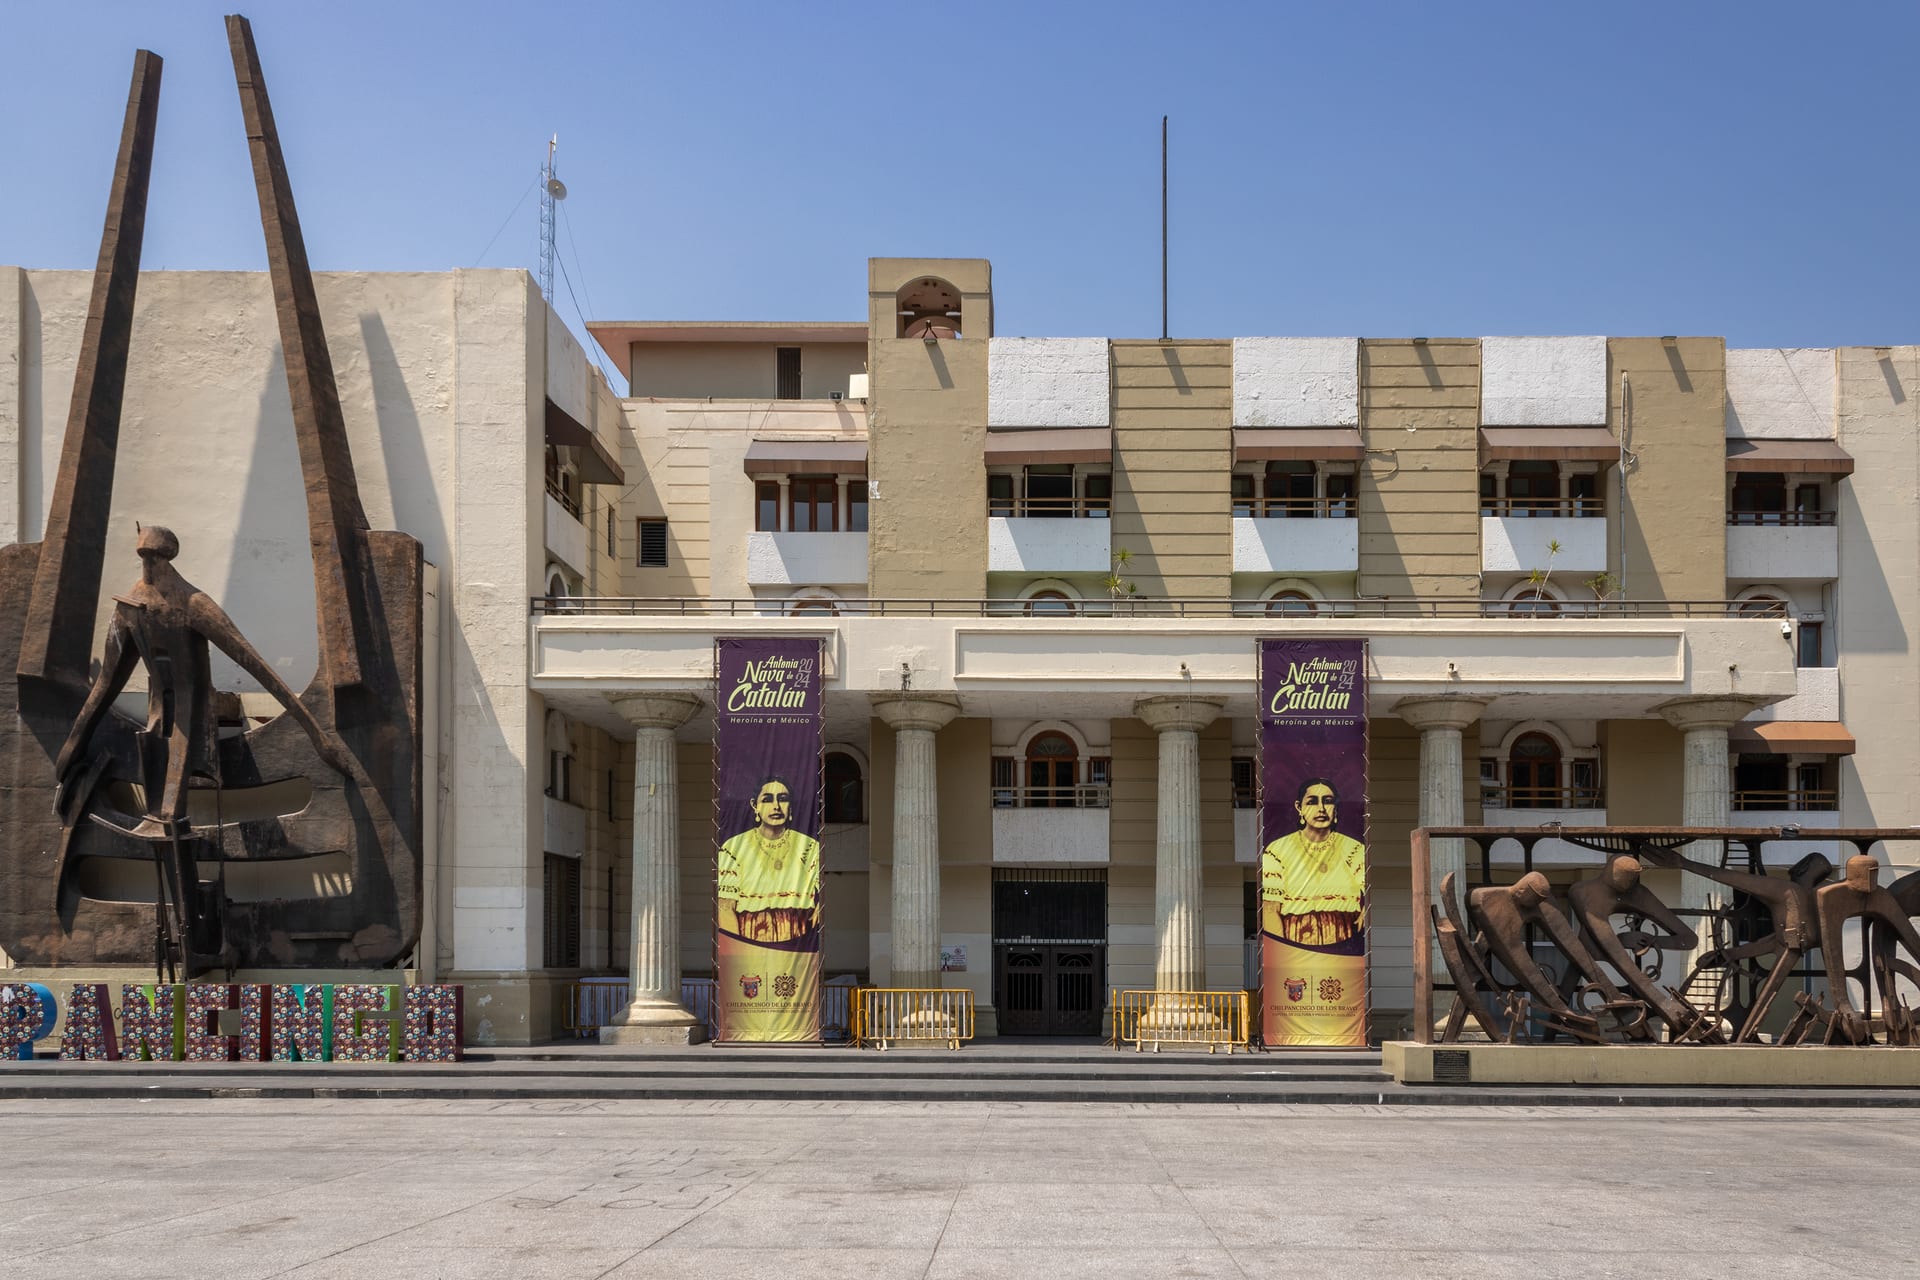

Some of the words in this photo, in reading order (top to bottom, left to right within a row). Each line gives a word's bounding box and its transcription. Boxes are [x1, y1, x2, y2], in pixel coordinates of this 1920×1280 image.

[762, 655, 799, 669] Antonia
[799, 658, 814, 673] 20
[1305, 657, 1342, 670] Antonia
[1342, 660, 1357, 675] 20
[737, 660, 785, 684] Nava
[786, 671, 794, 680] de
[1280, 662, 1328, 685] Nava
[1330, 672, 1338, 681] de
[794, 673, 811, 688] 24
[1337, 674, 1355, 690] 24
[727, 682, 807, 712] Catalán
[1271, 684, 1351, 714] Catalán
[780, 716, 810, 724] México
[1324, 718, 1354, 726] México
